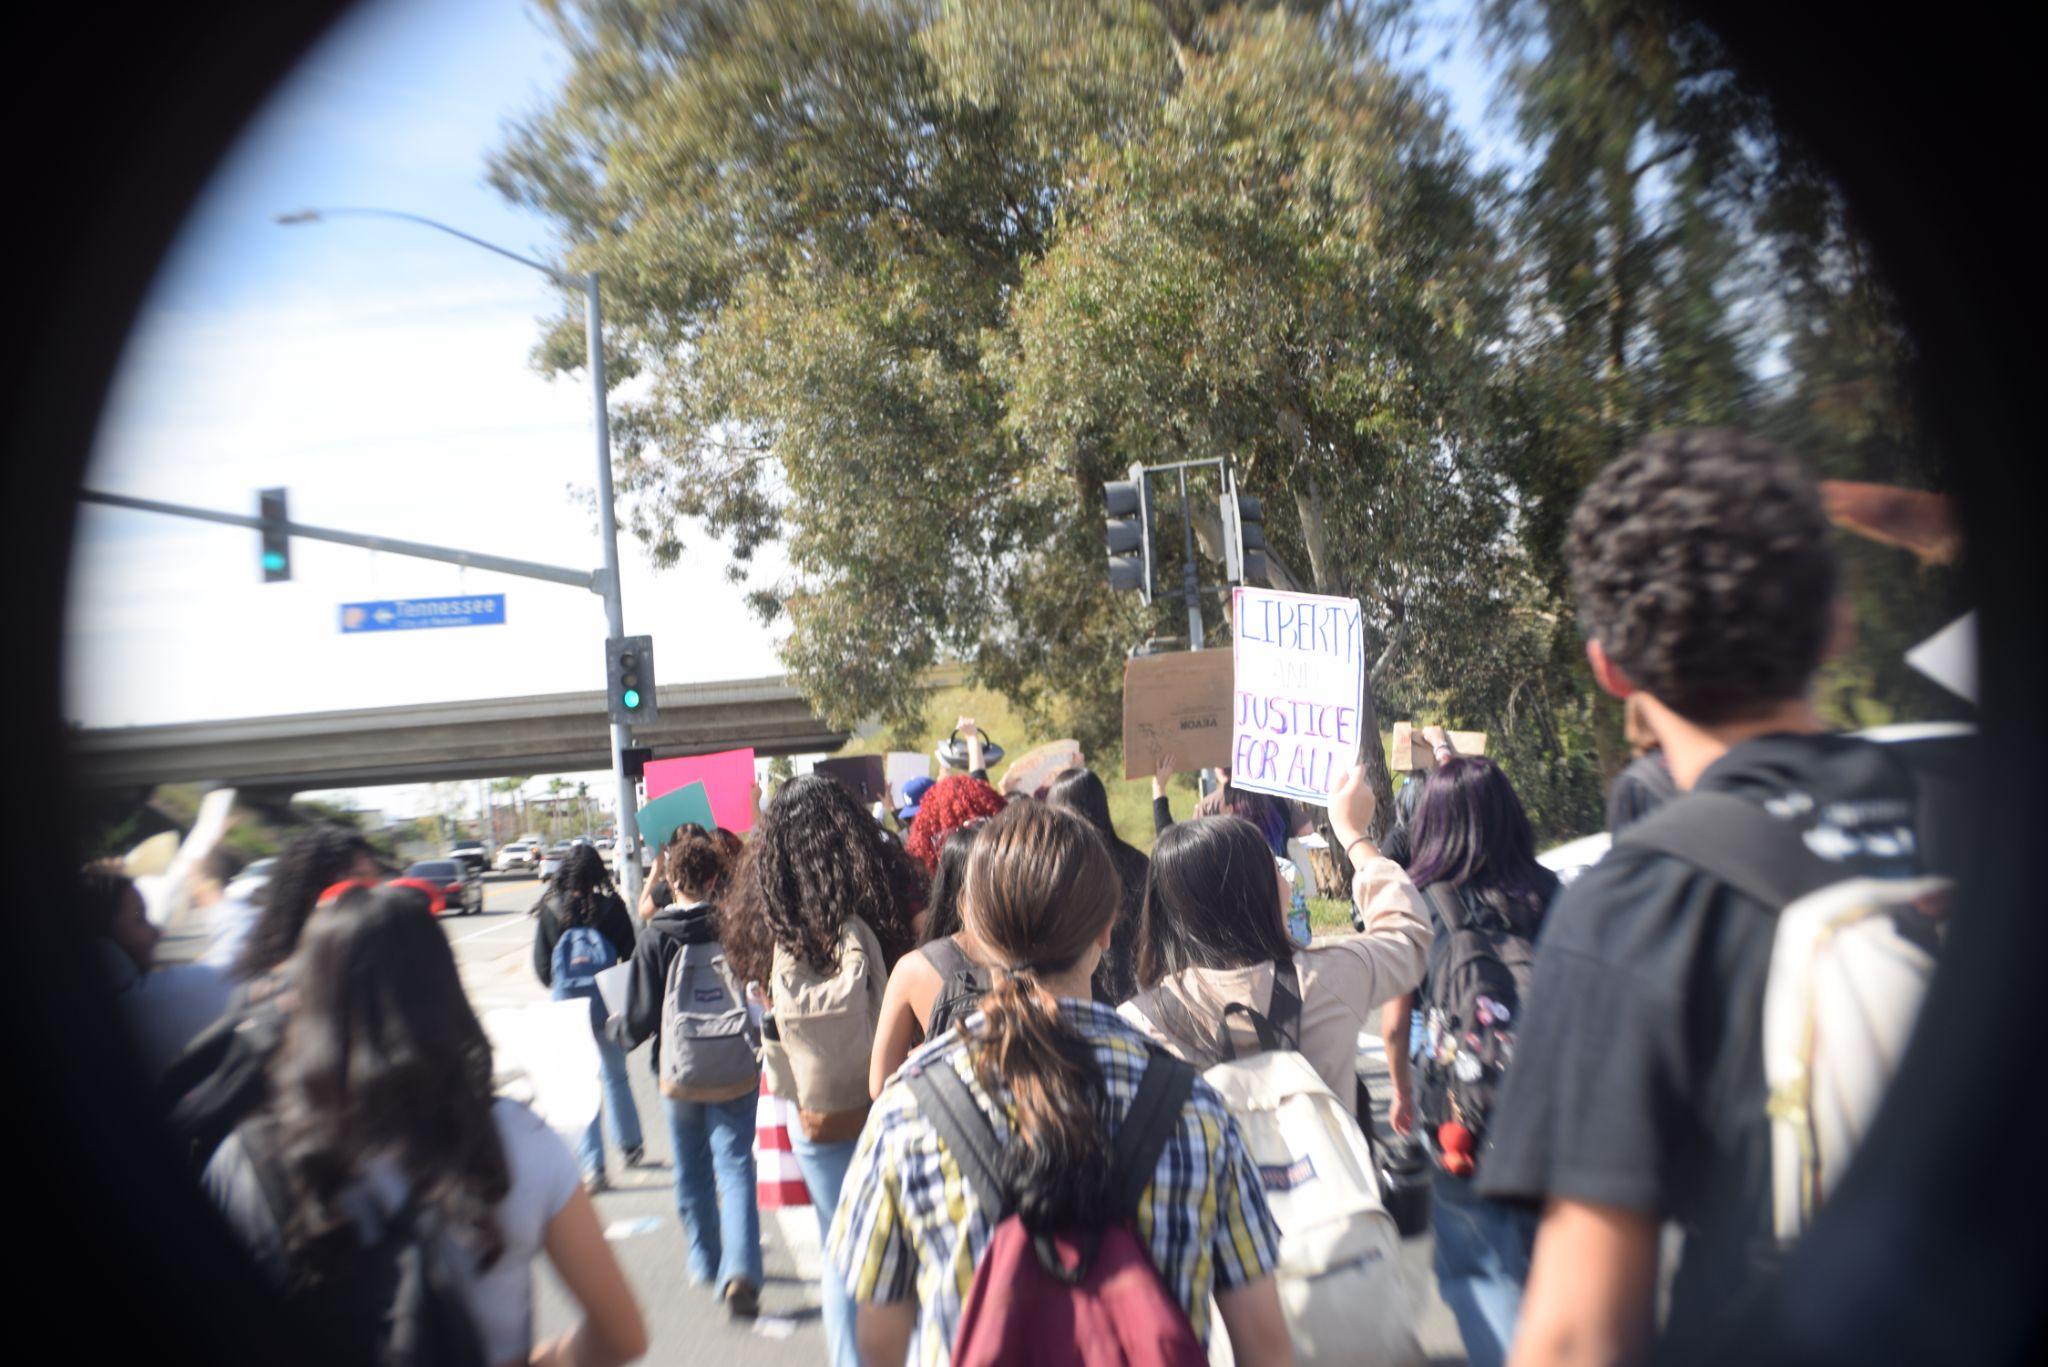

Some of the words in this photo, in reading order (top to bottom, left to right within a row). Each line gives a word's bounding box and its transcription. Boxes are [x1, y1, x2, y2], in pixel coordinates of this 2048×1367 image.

[395, 599, 495, 618] Tennessee
[1241, 595, 1359, 664] LIBERTY
[1238, 690, 1355, 745] JUSTICE
[1236, 734, 1280, 782] FOR
[1287, 743, 1333, 794] ALL
